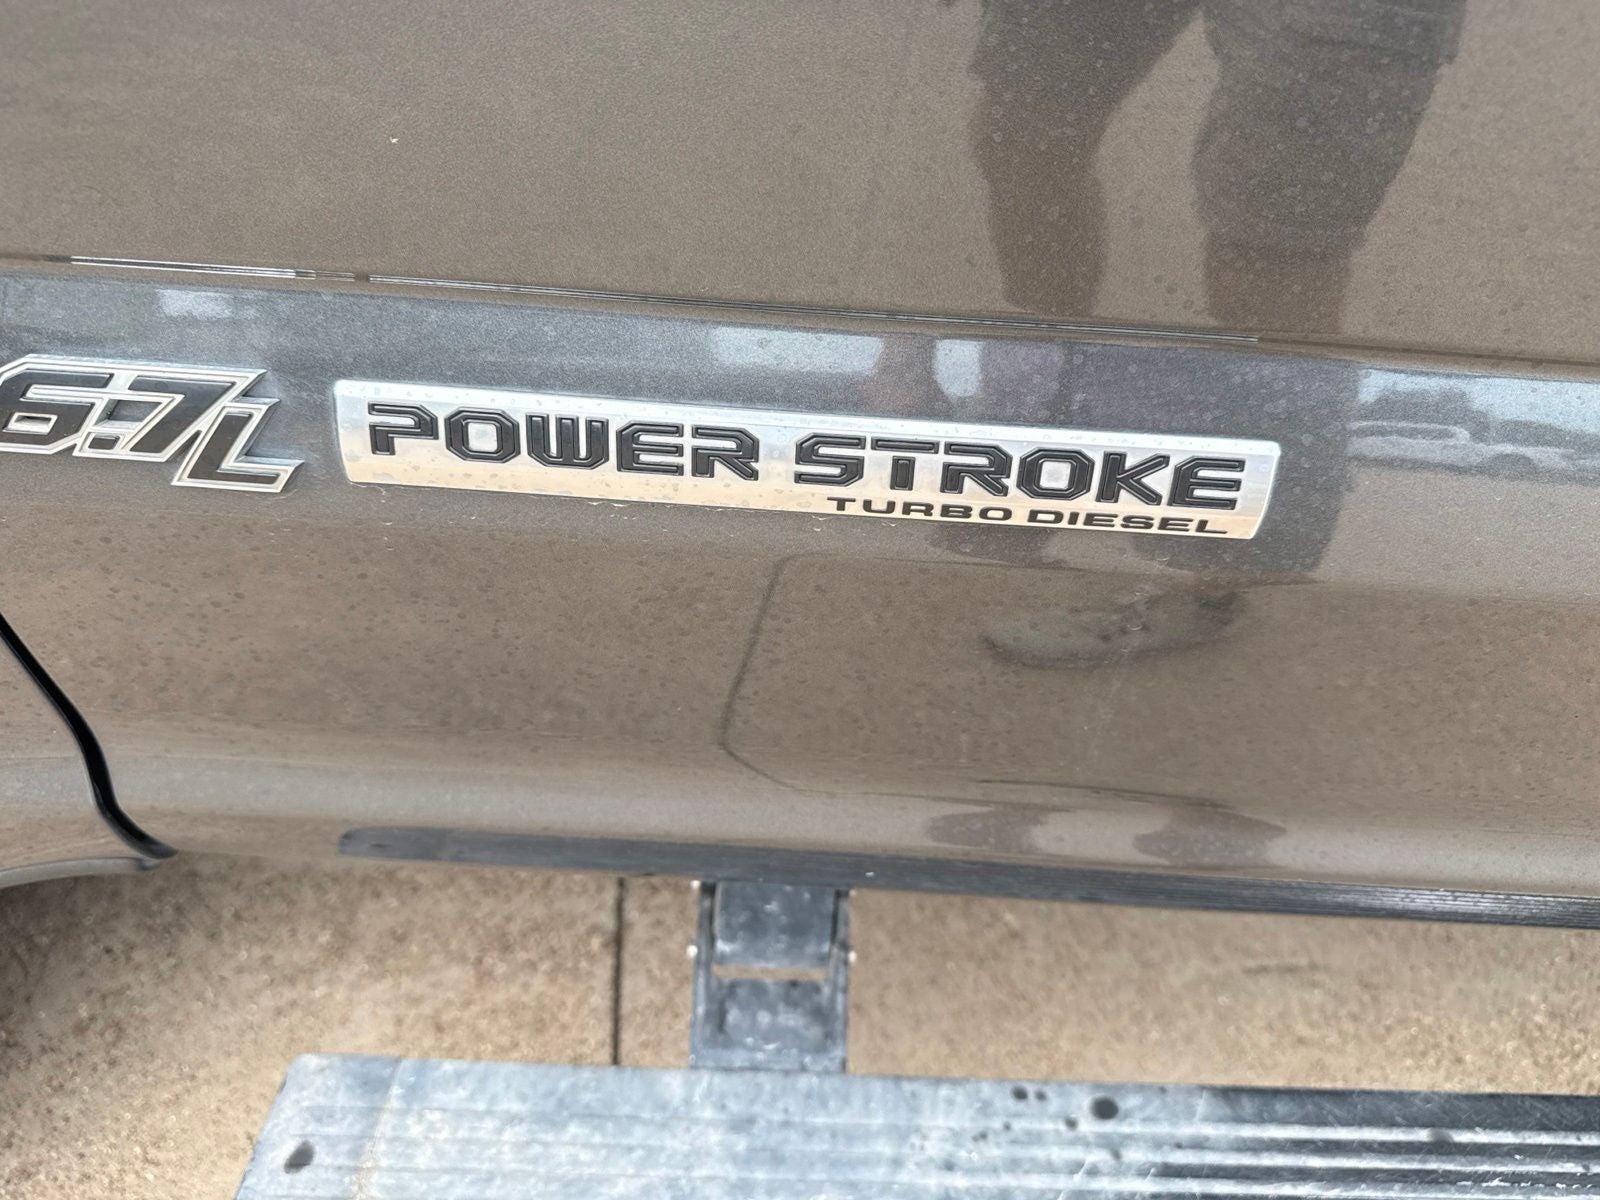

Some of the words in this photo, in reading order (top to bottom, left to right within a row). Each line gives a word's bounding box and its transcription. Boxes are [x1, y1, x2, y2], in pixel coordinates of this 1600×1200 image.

[0, 355, 302, 492] 6.7L
[368, 401, 760, 481] POWER
[794, 432, 1246, 510] STROKE
[827, 496, 1012, 522] TURBO
[1026, 508, 1229, 535] DIESEL
